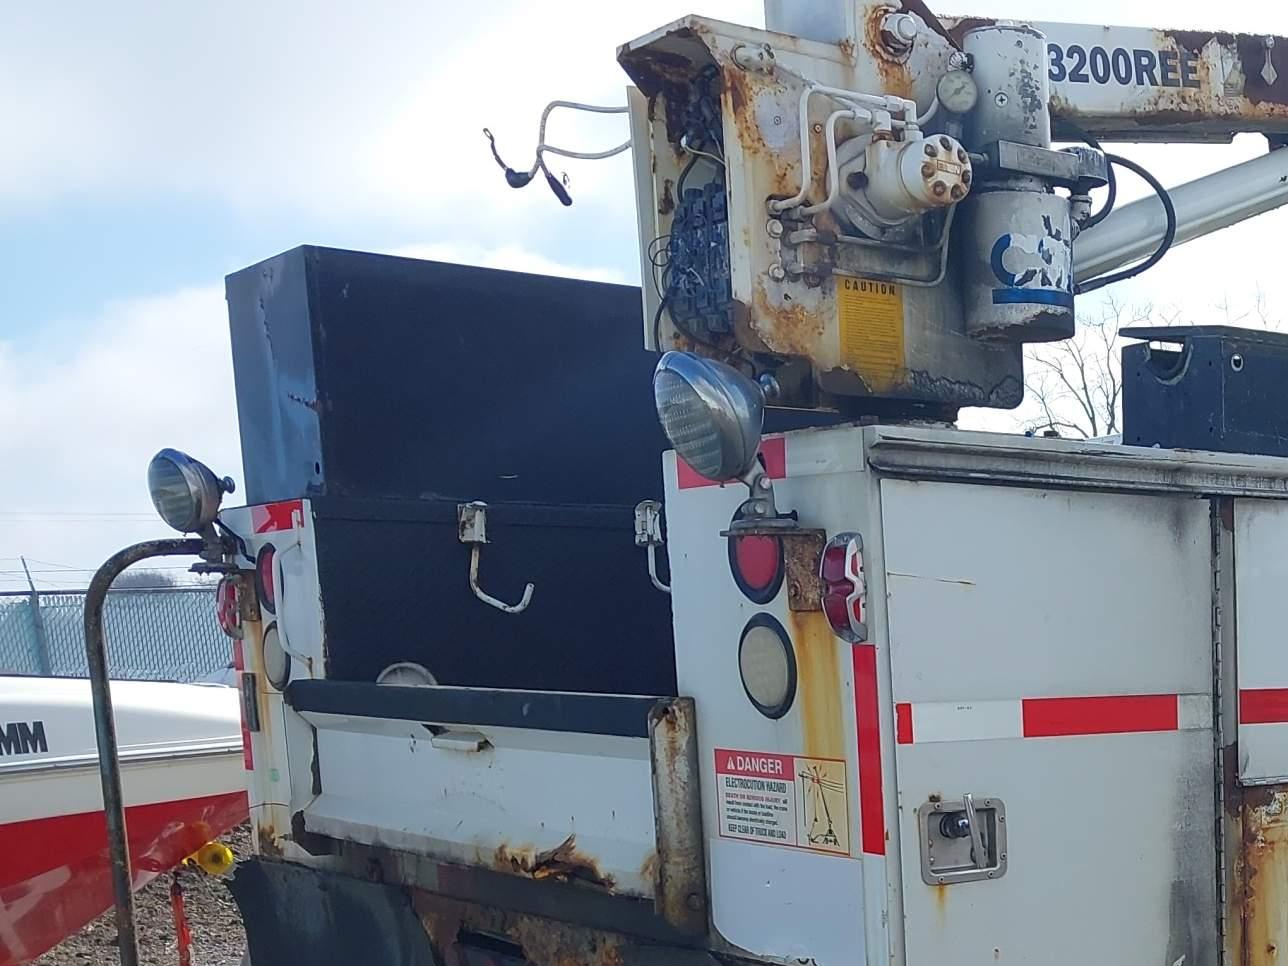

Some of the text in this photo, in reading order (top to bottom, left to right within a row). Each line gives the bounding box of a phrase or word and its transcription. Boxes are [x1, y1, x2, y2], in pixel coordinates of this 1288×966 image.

[1047, 43, 1201, 88] 3200REE
[844, 279, 896, 296] CAUTION
[736, 756, 783, 775] DANGER
[725, 777, 787, 793] ELECTROCUTION HAZARD
